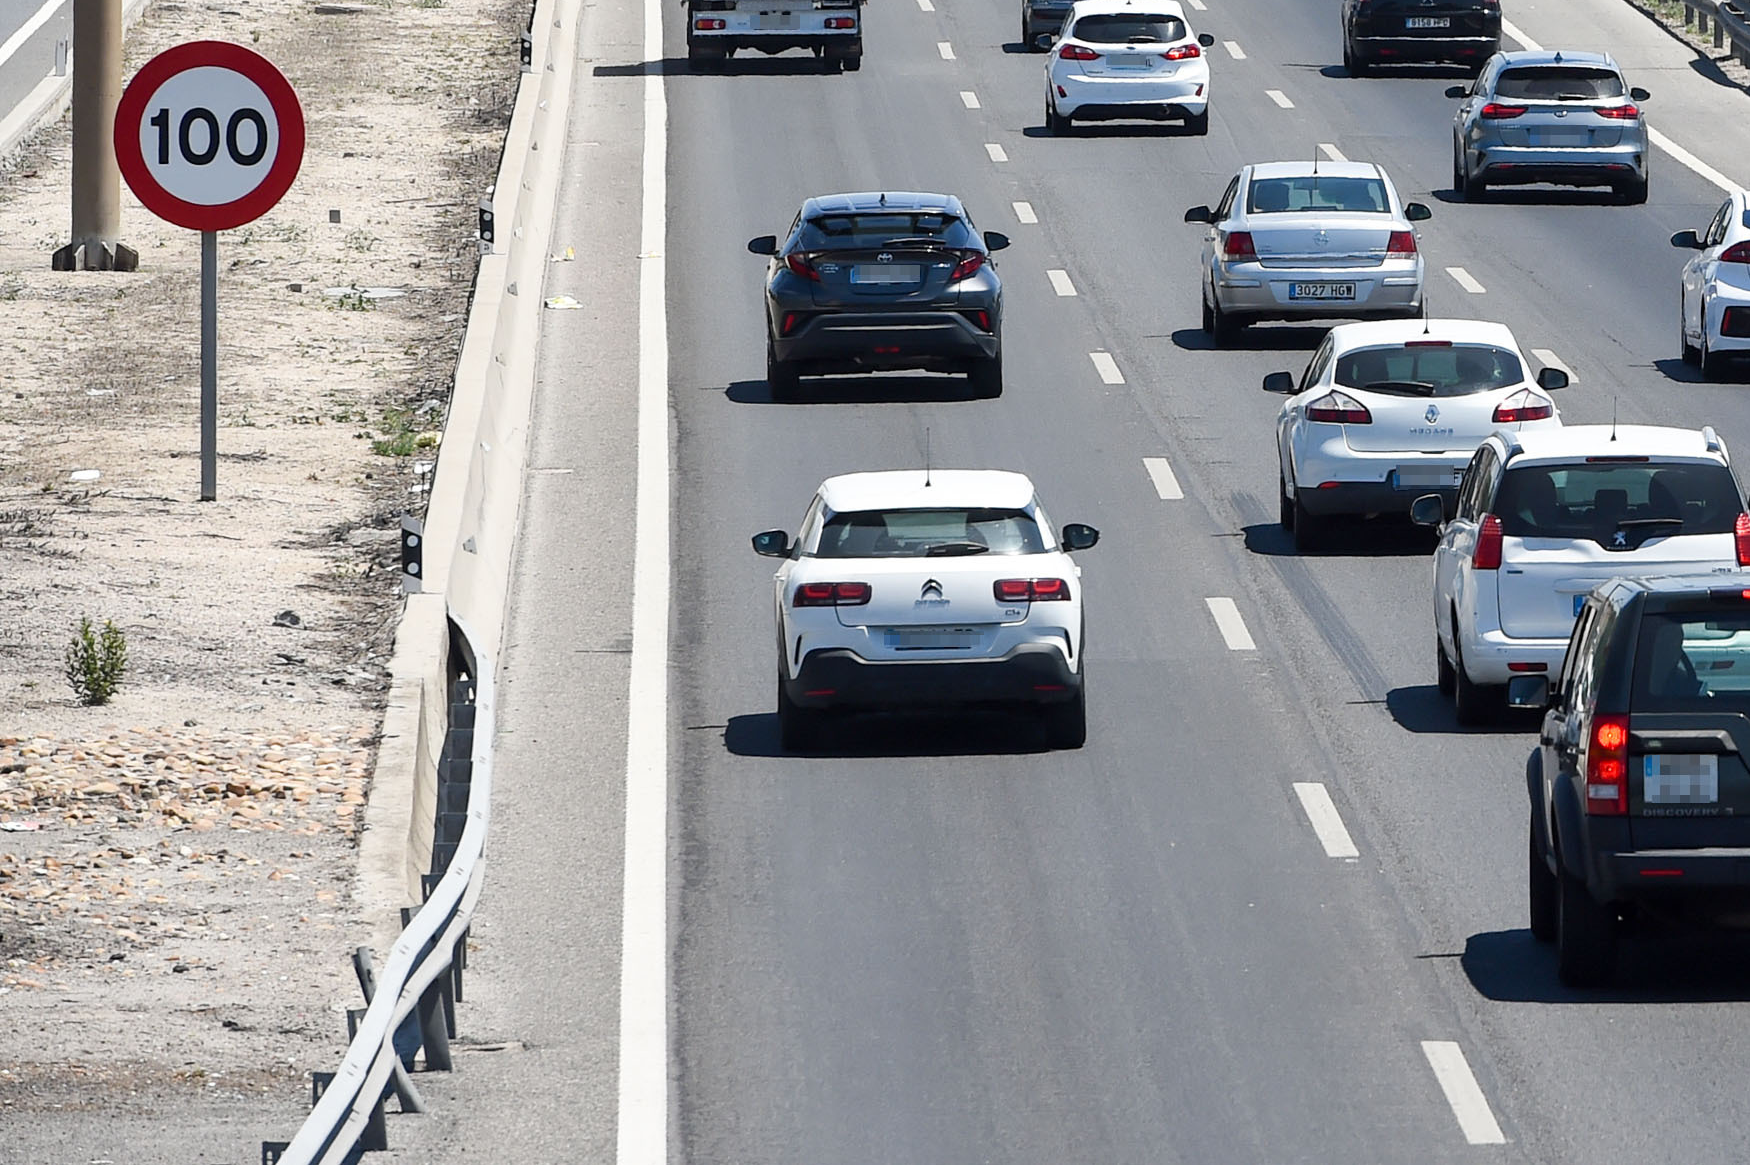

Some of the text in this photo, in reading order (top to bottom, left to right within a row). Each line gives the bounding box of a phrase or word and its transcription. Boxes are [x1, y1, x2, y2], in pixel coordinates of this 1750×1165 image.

[150, 107, 268, 166] 100
[1297, 285, 1353, 296] 3027 HGW
[1643, 808, 1719, 817] DISCOVERY
